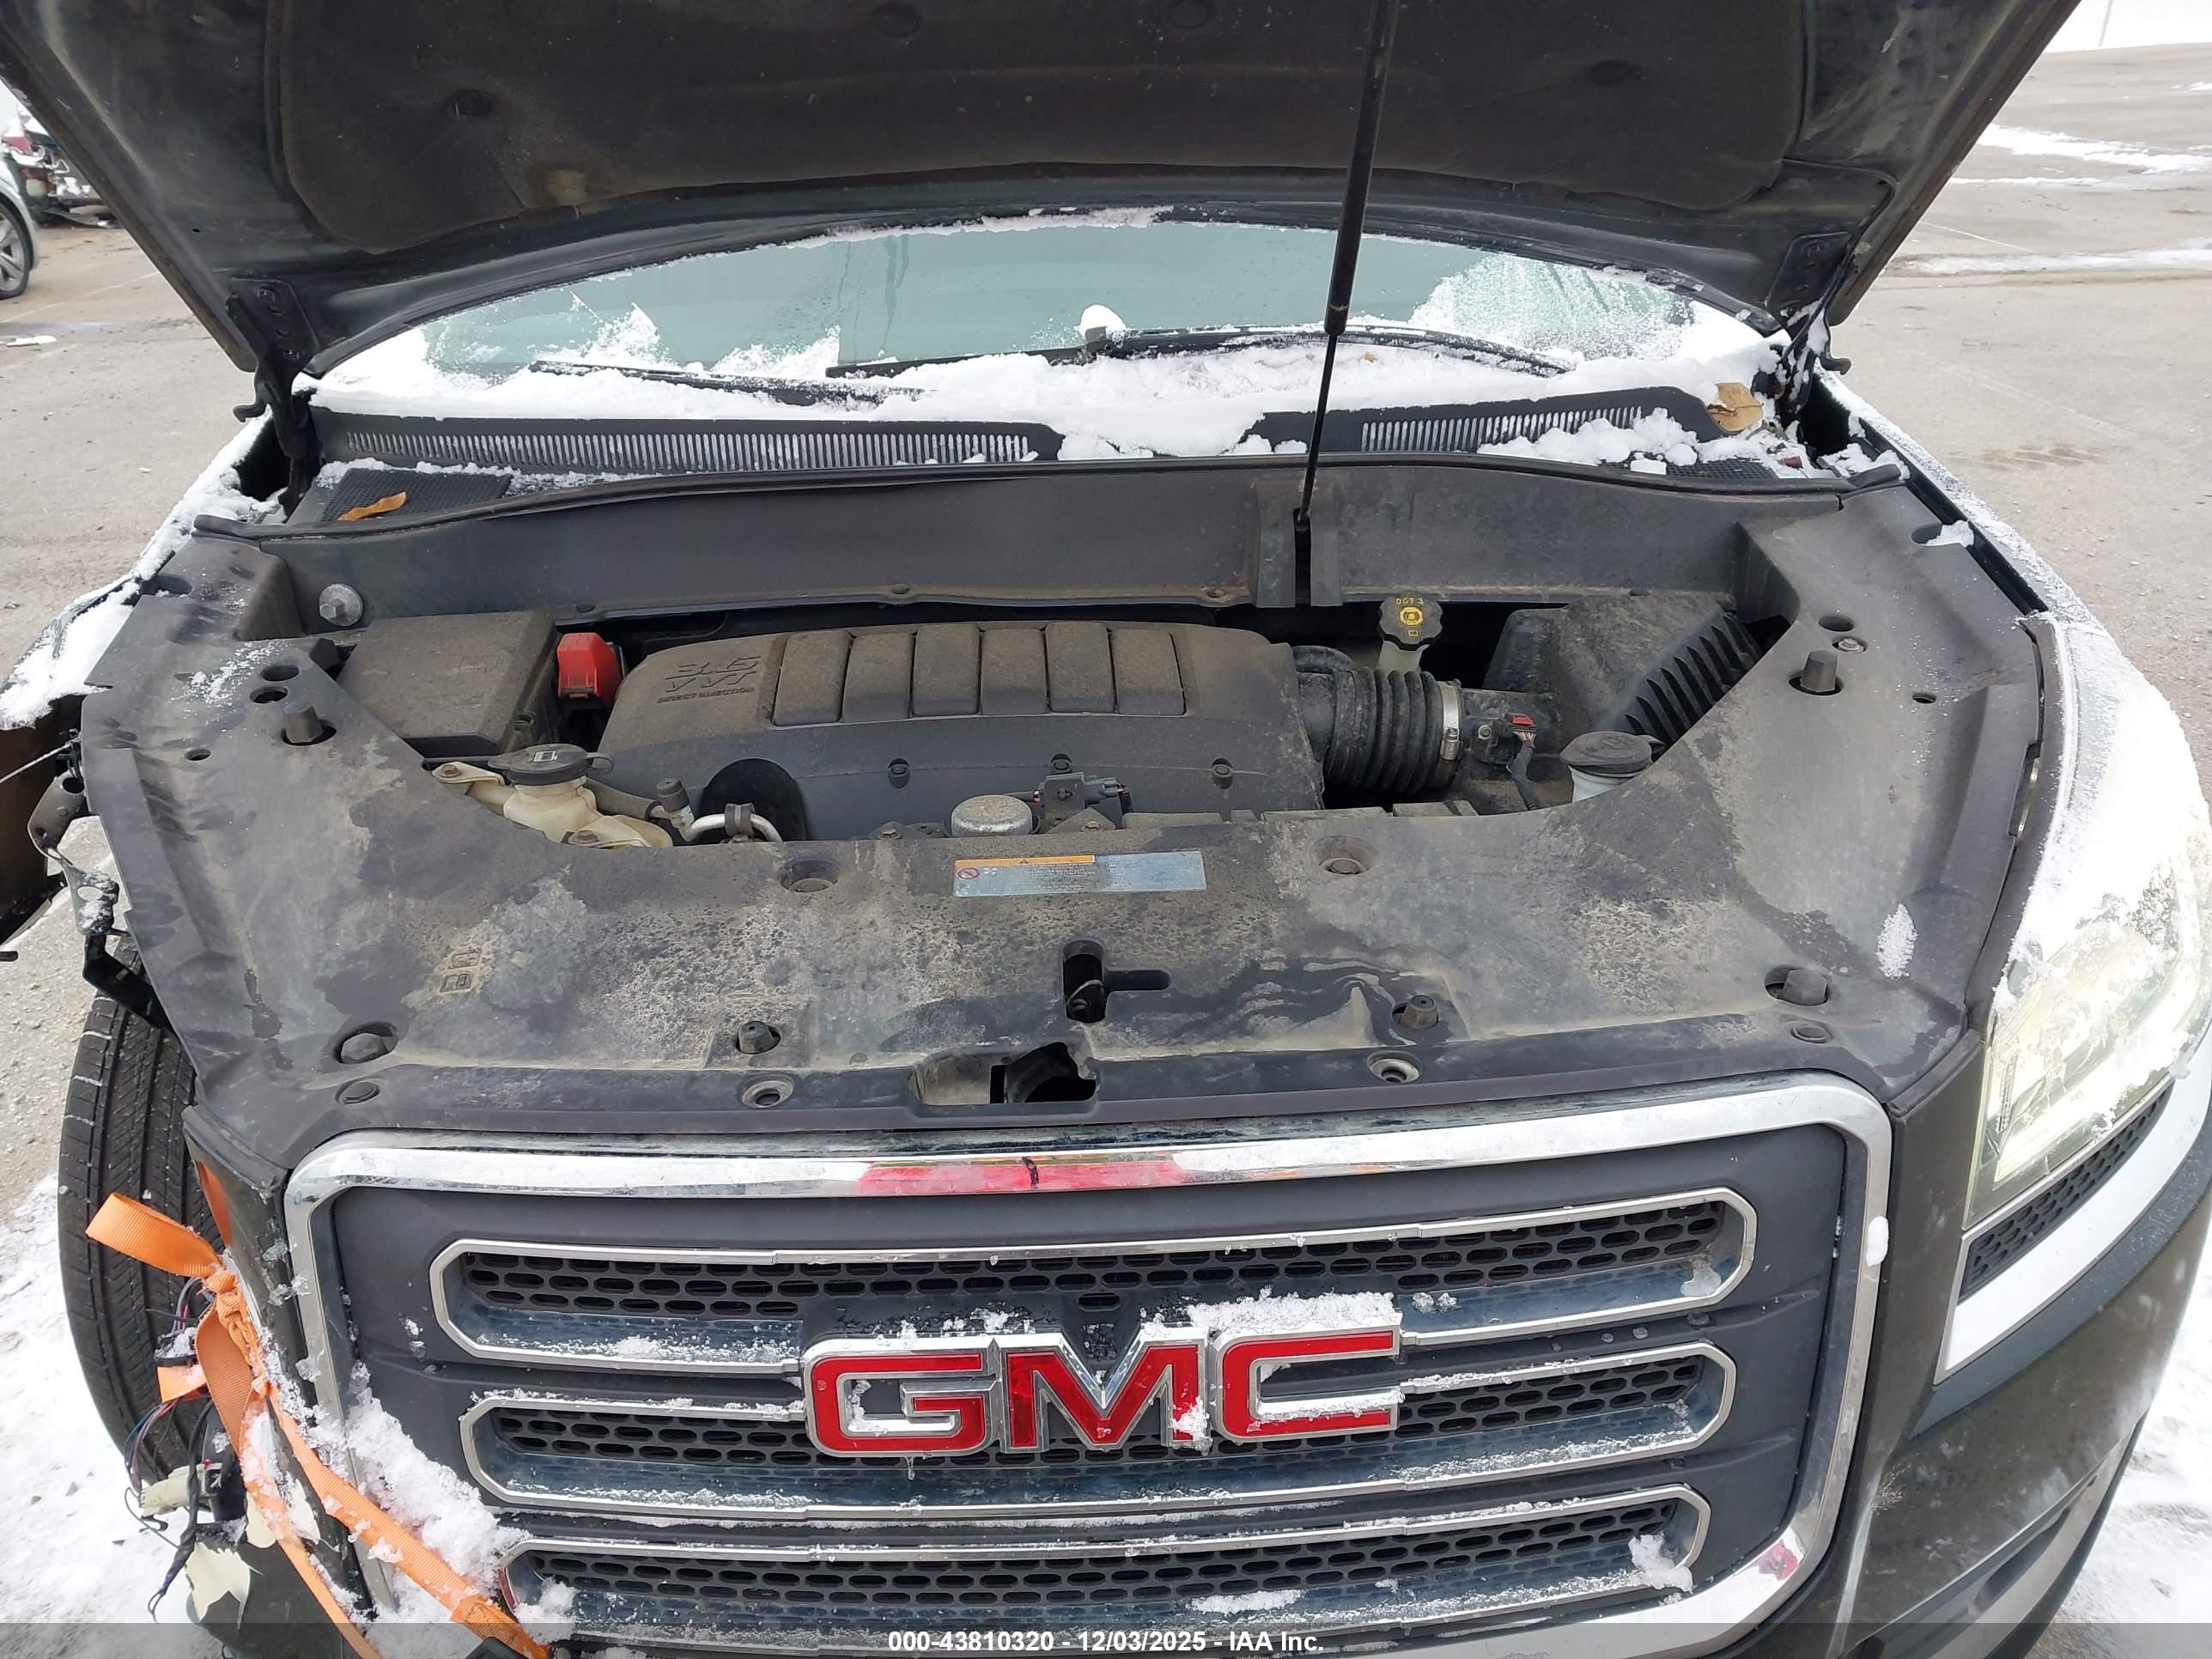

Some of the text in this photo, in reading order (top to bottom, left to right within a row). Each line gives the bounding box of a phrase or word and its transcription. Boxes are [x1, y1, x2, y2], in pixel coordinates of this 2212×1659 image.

[665, 671, 757, 693] VVT
[657, 693, 696, 704] DIRECT
[804, 1318, 1401, 1458] GMC
